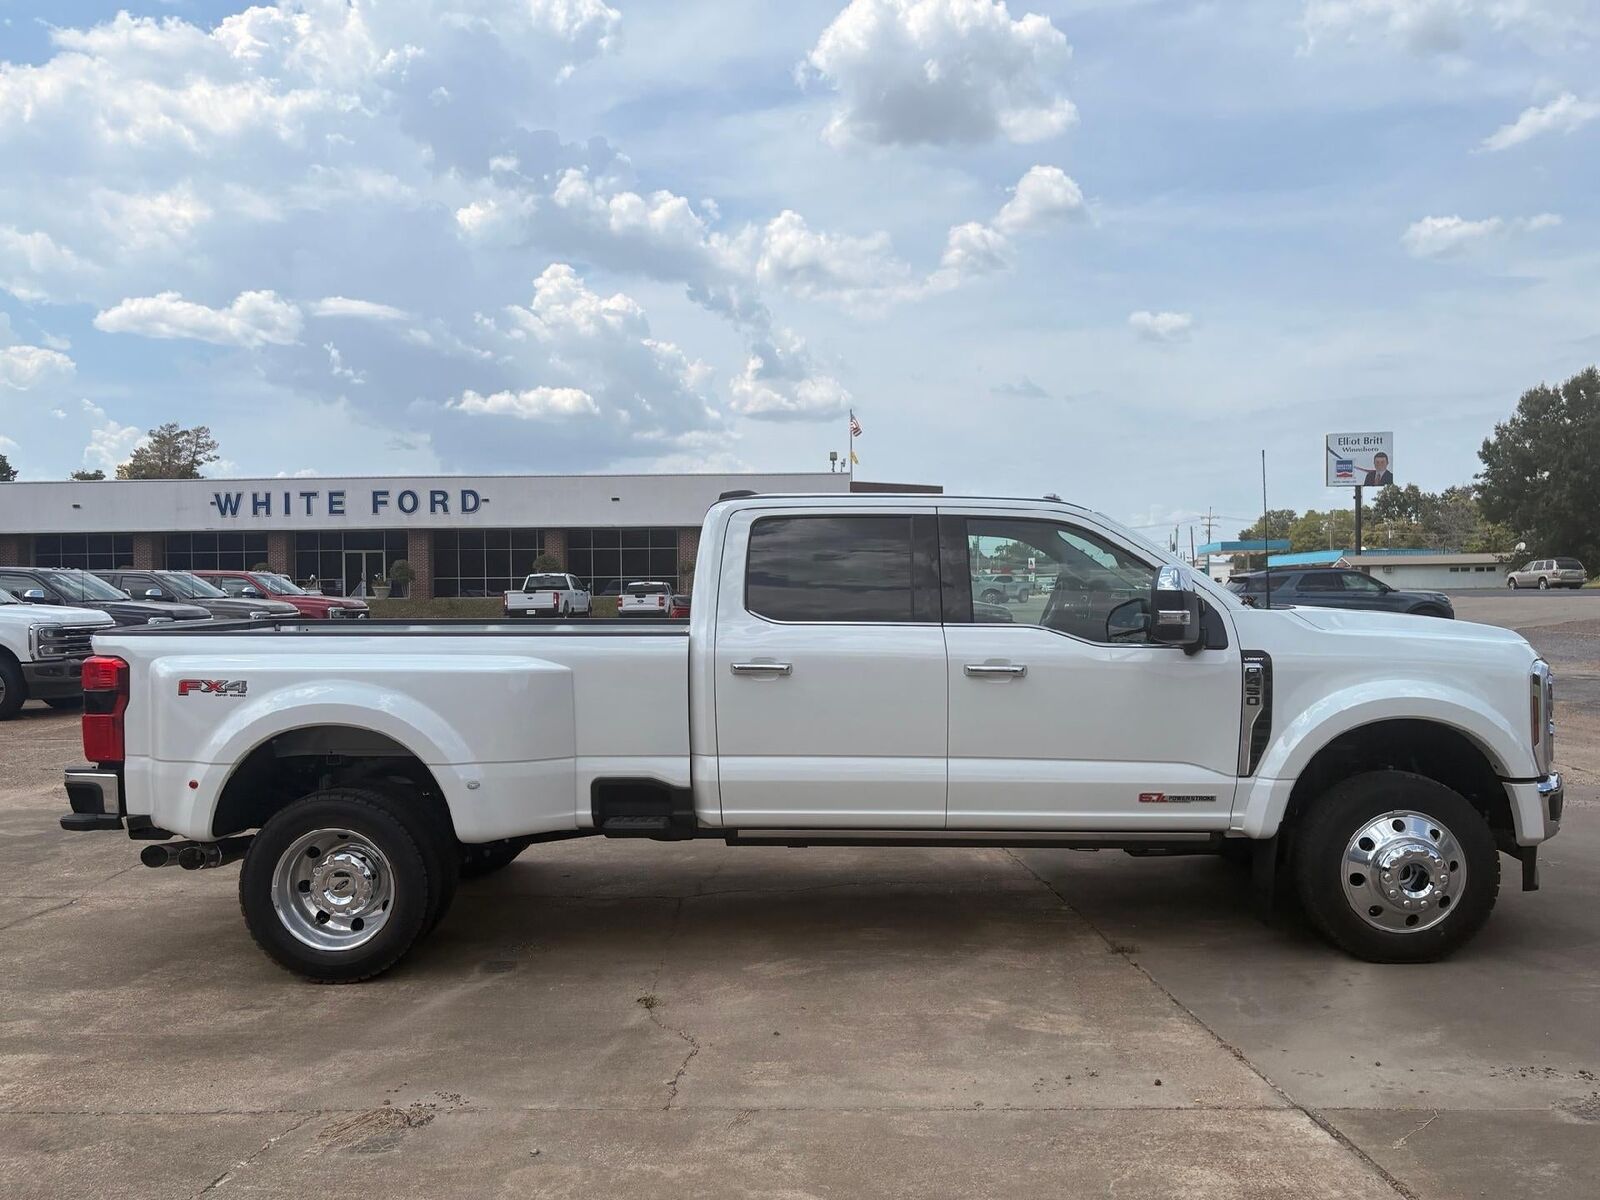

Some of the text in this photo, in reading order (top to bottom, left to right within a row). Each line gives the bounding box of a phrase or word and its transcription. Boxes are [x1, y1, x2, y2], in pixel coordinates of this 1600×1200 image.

[1363, 436, 1383, 445] Britt
[213, 489, 482, 517] WHITE FORD
[178, 679, 247, 696] FX4
